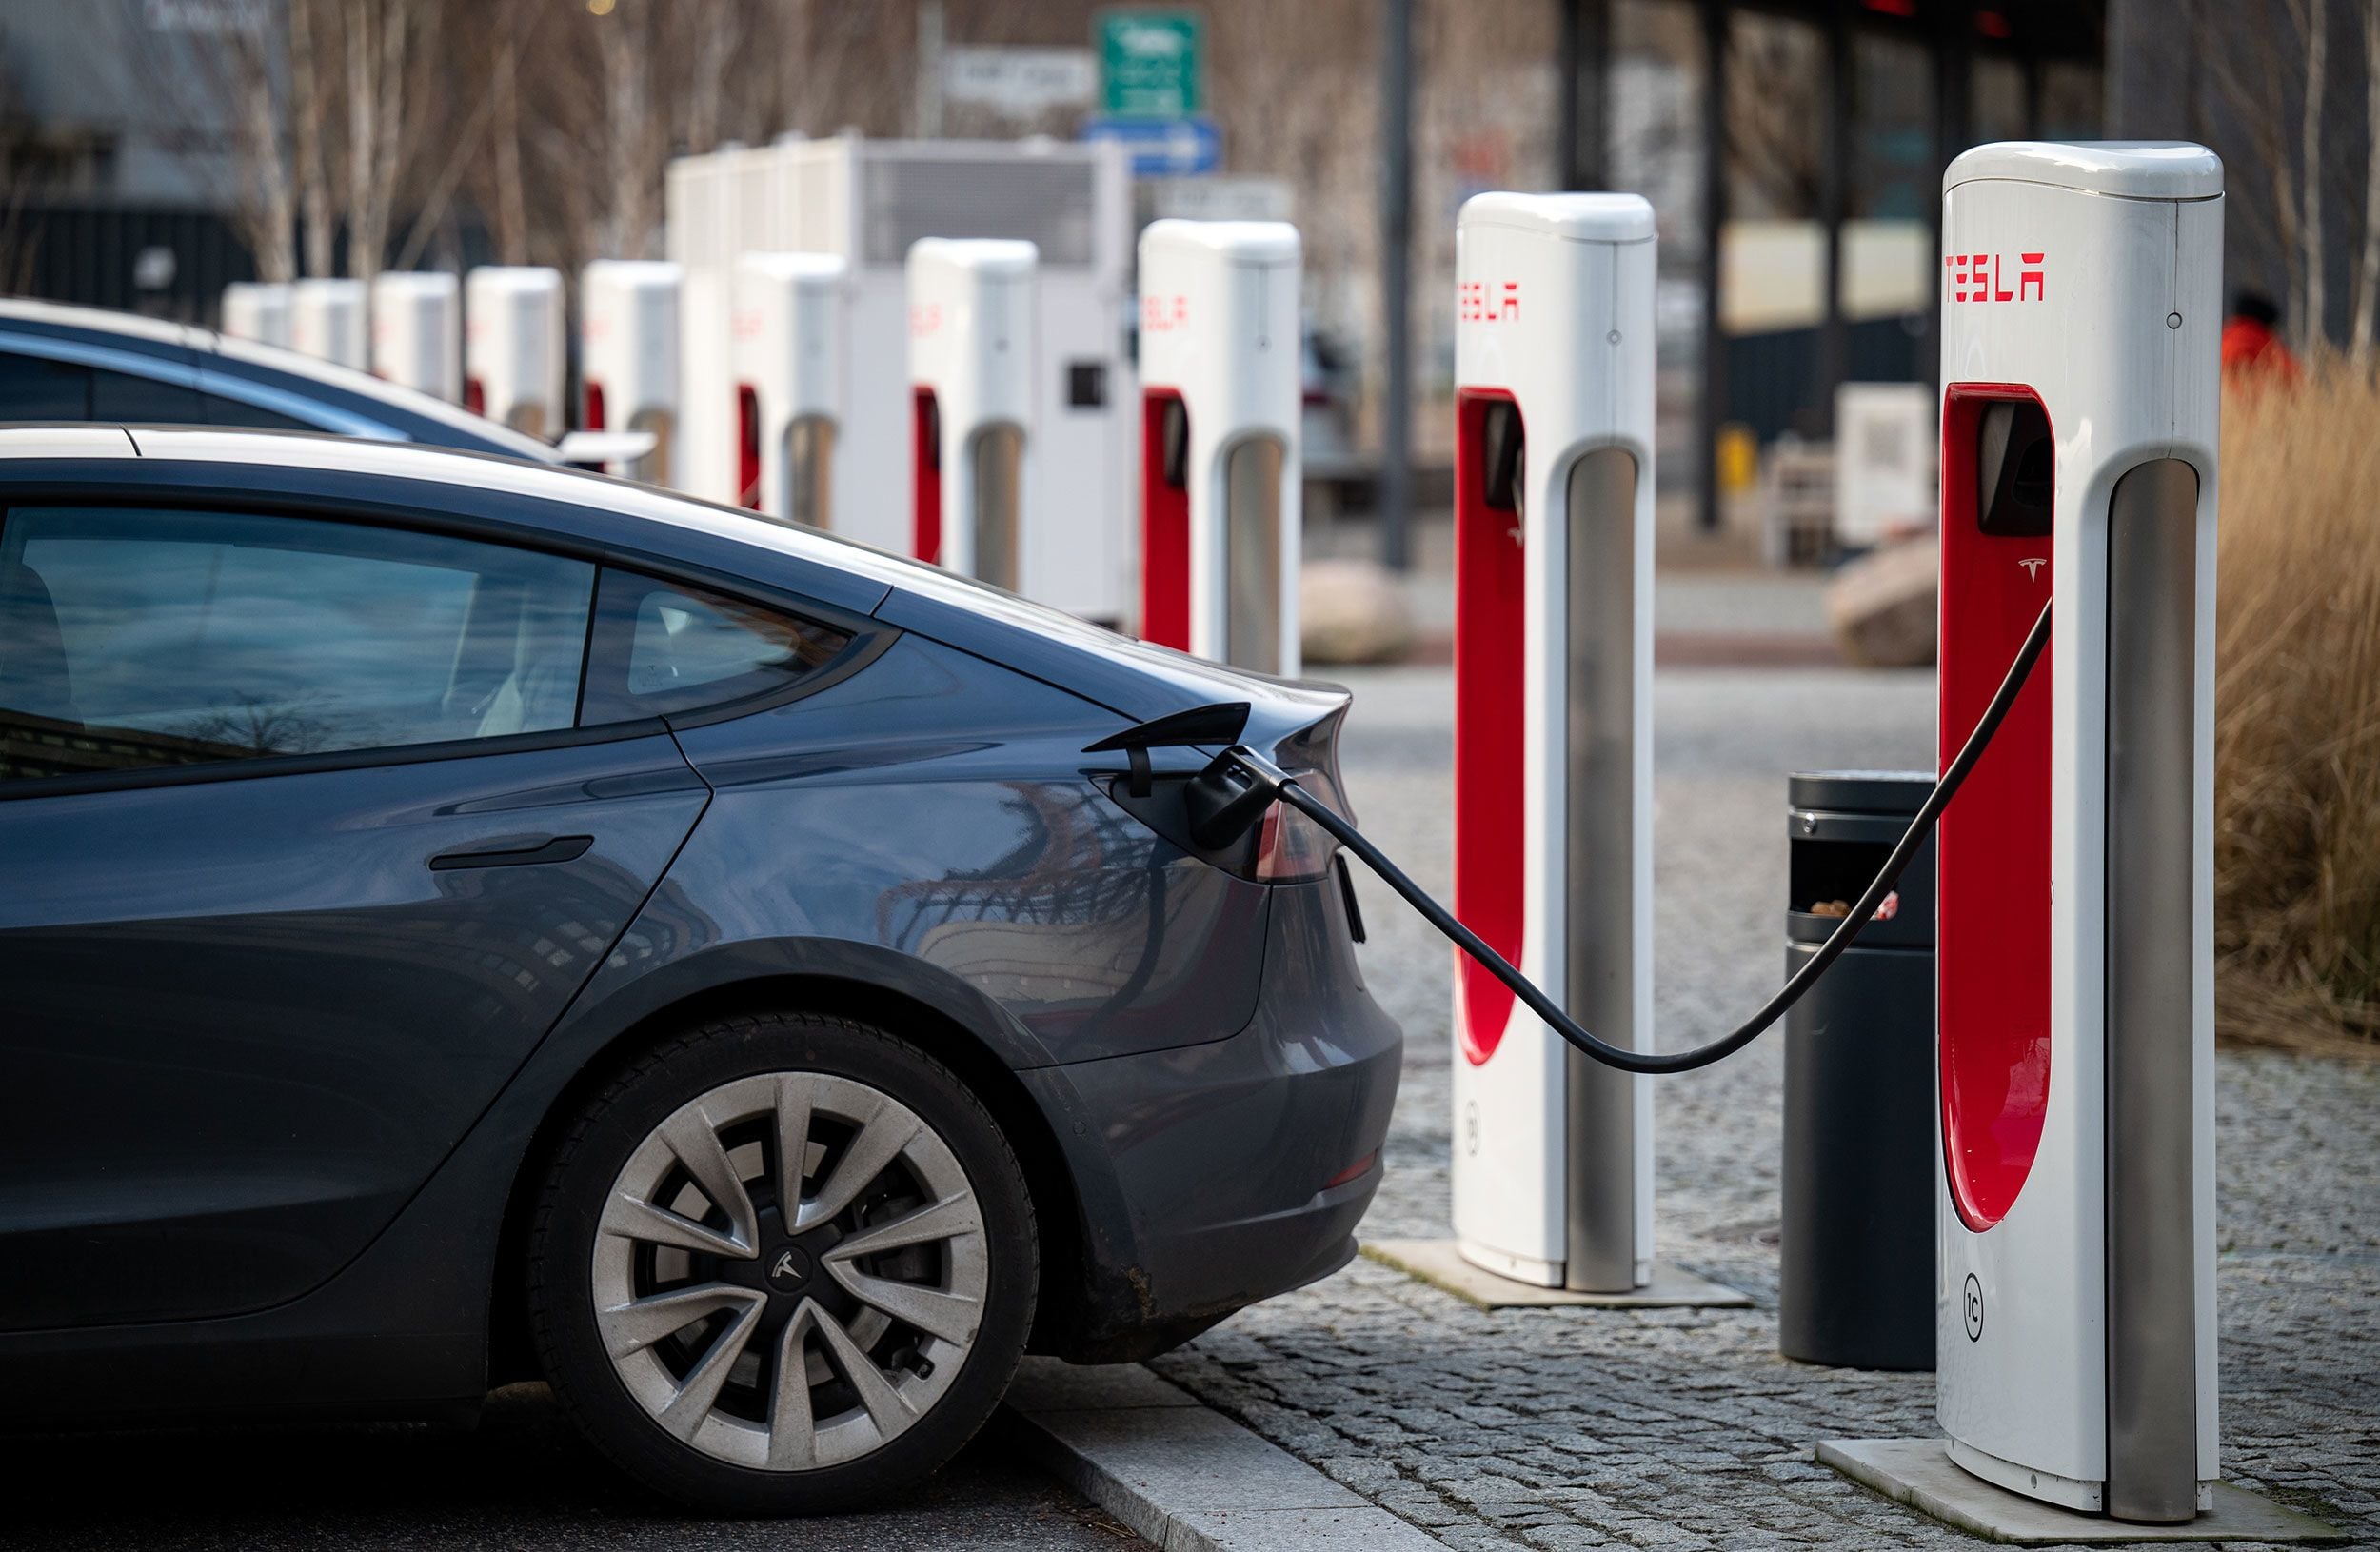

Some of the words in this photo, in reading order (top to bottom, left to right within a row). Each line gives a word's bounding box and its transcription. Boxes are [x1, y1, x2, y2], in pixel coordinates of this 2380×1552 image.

[1945, 252, 2045, 303] TESLA
[1458, 282, 1519, 321] ESLA
[1967, 1292, 1979, 1323] 1C
